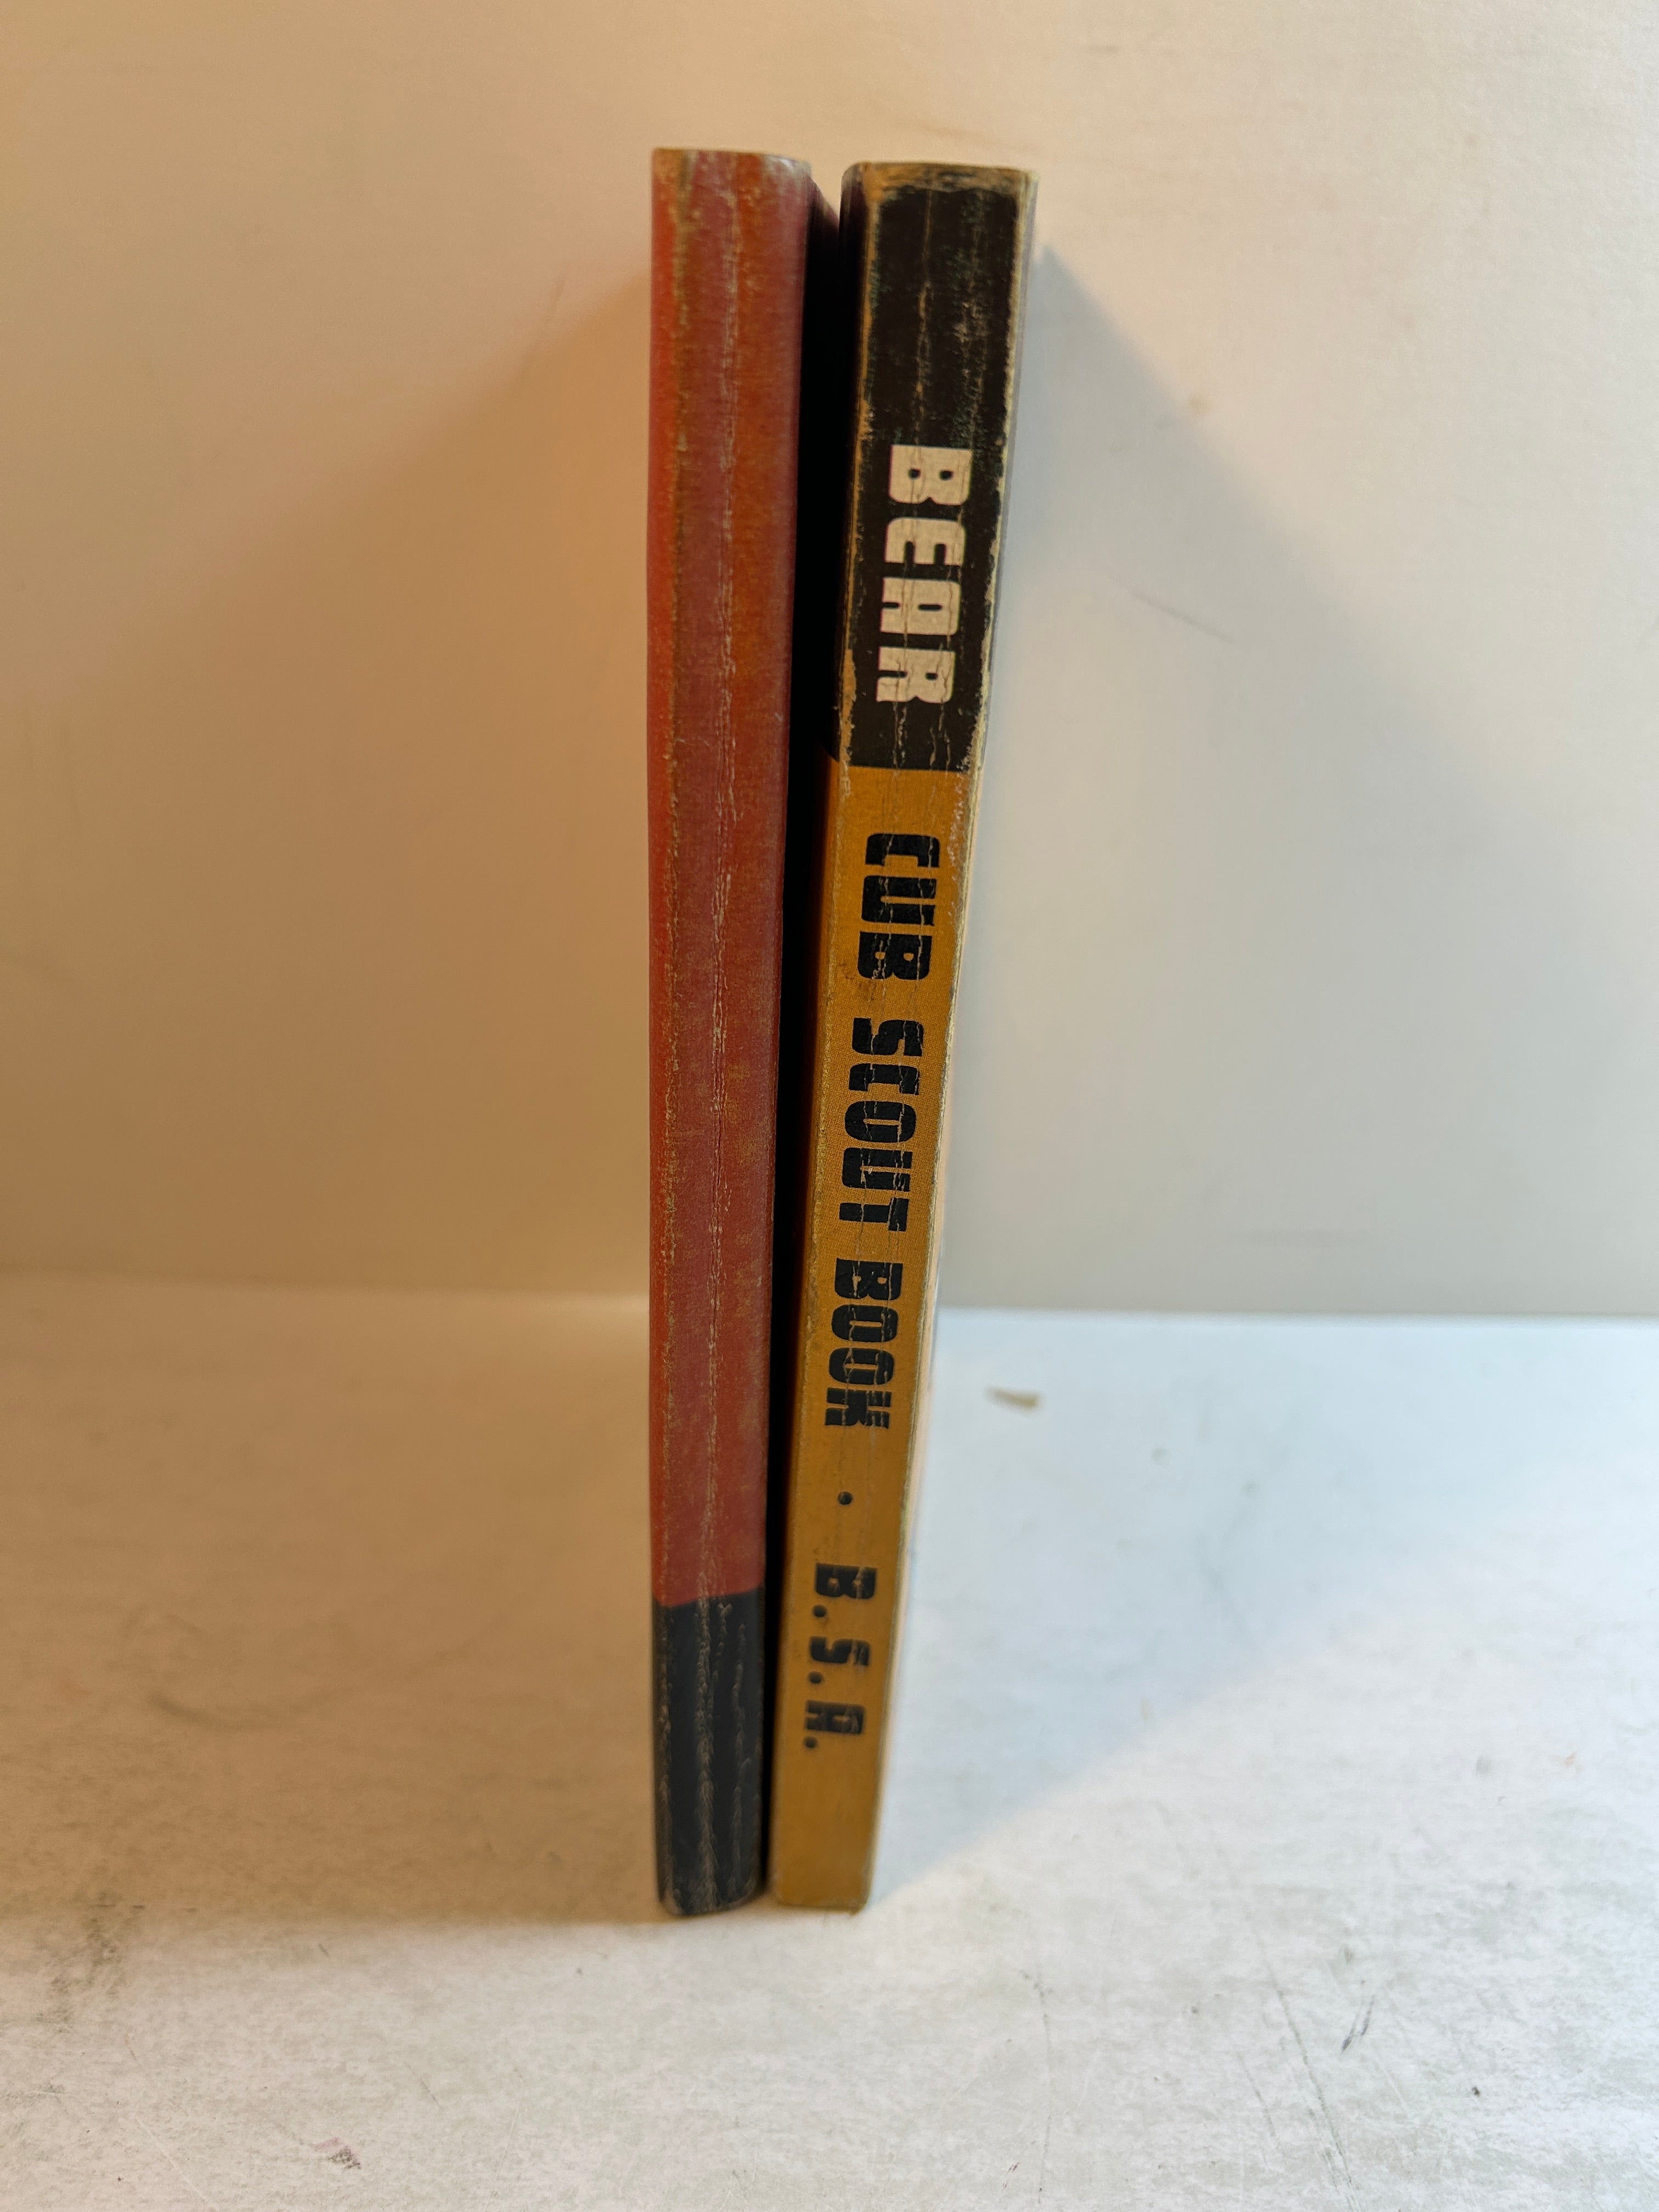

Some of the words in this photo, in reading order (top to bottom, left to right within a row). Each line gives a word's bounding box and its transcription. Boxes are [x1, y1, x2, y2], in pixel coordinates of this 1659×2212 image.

[876, 444, 973, 703] BEAR
[857, 833, 940, 980] CUB
[839, 1017, 924, 1232] SCOUT
[825, 1257, 904, 1429] BOOK
[803, 1562, 878, 1748] B.S.A.
